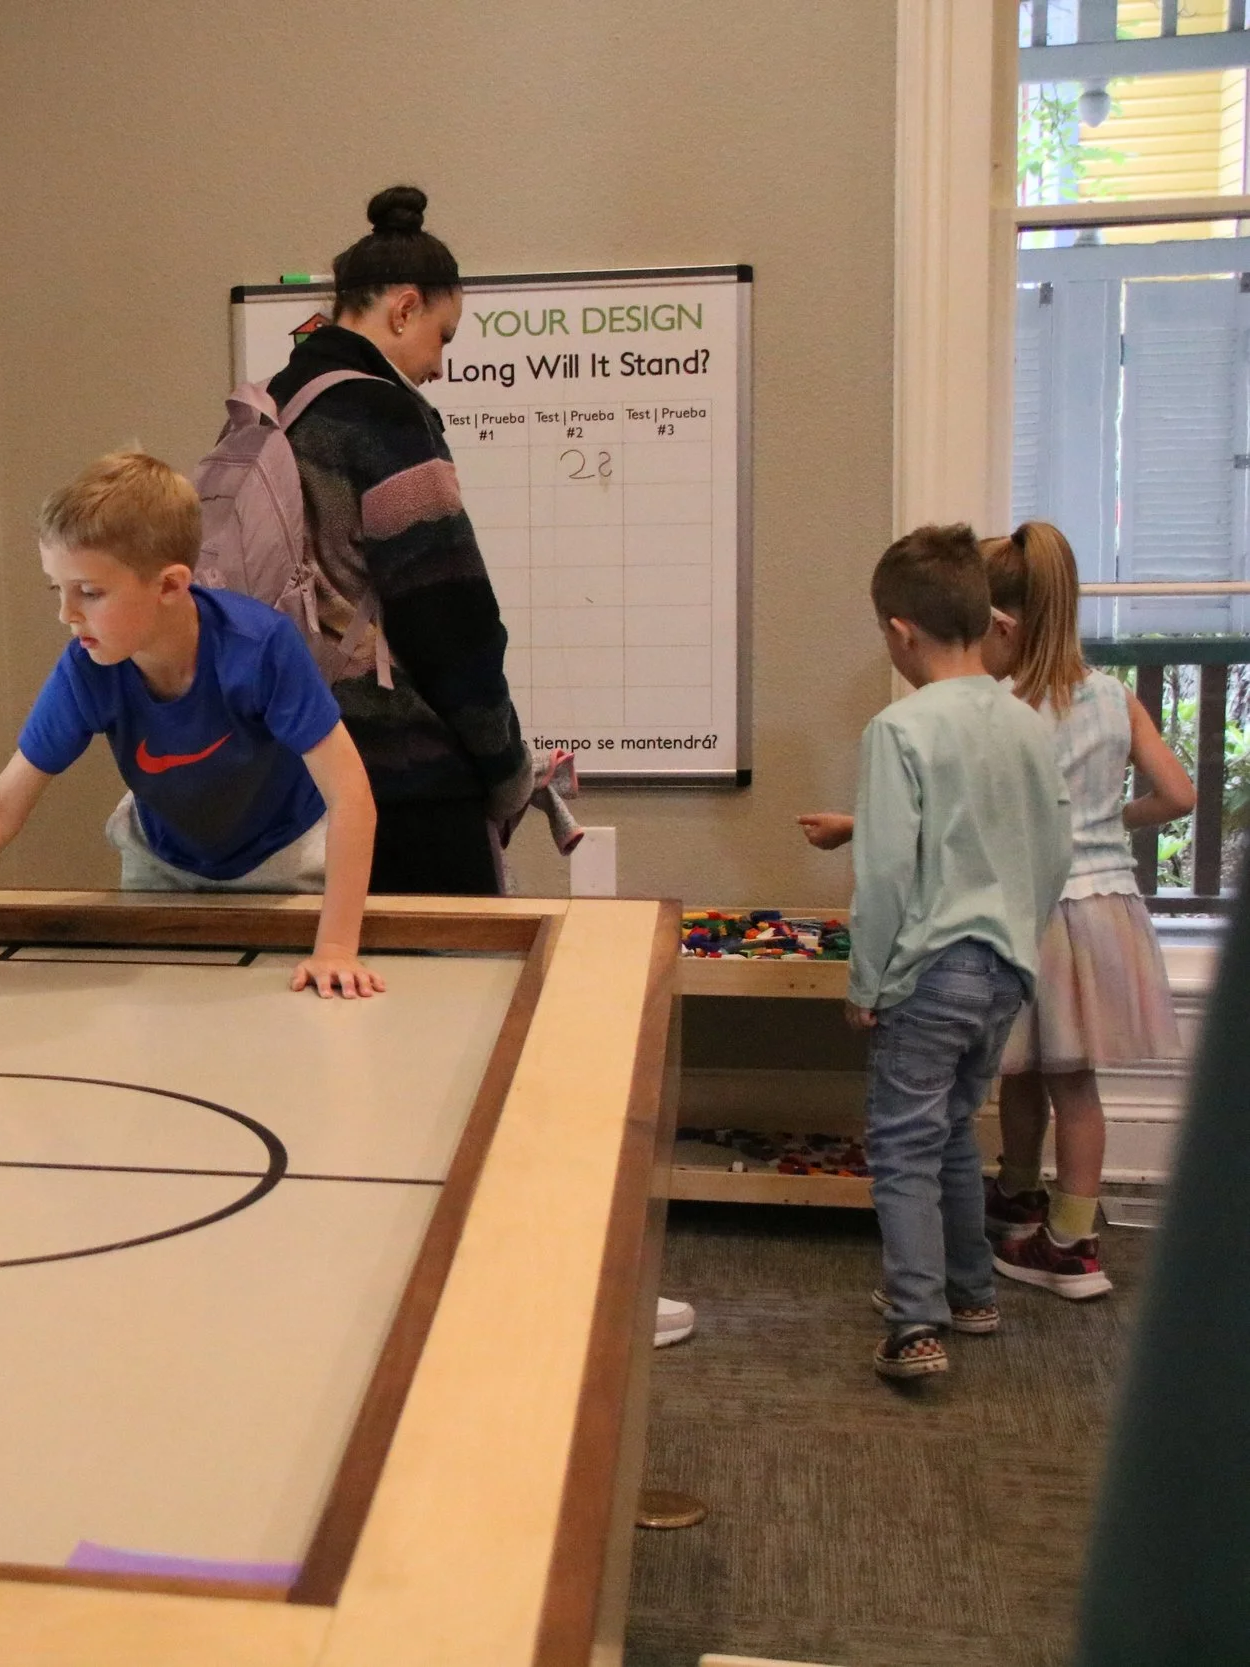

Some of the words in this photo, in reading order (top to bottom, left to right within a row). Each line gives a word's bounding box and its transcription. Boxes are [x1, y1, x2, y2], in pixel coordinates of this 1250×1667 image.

[473, 309, 569, 338] YOUR
[582, 303, 703, 334] DESIGN
[447, 358, 515, 387] Long
[526, 353, 579, 379] Will
[591, 353, 610, 378] It
[620, 349, 710, 376] Stand?
[446, 414, 471, 426] Test
[481, 412, 525, 424] Prueba
[534, 411, 559, 423] Test
[570, 410, 615, 422] Prueba
[625, 408, 651, 420] Test
[661, 407, 706, 419] Prueba
[478, 430, 494, 441] #1
[566, 427, 584, 439] #2
[657, 424, 675, 436] #3
[533, 735, 592, 753] tiempo
[597, 738, 615, 750] se
[620, 734, 719, 750] mantendrá?
